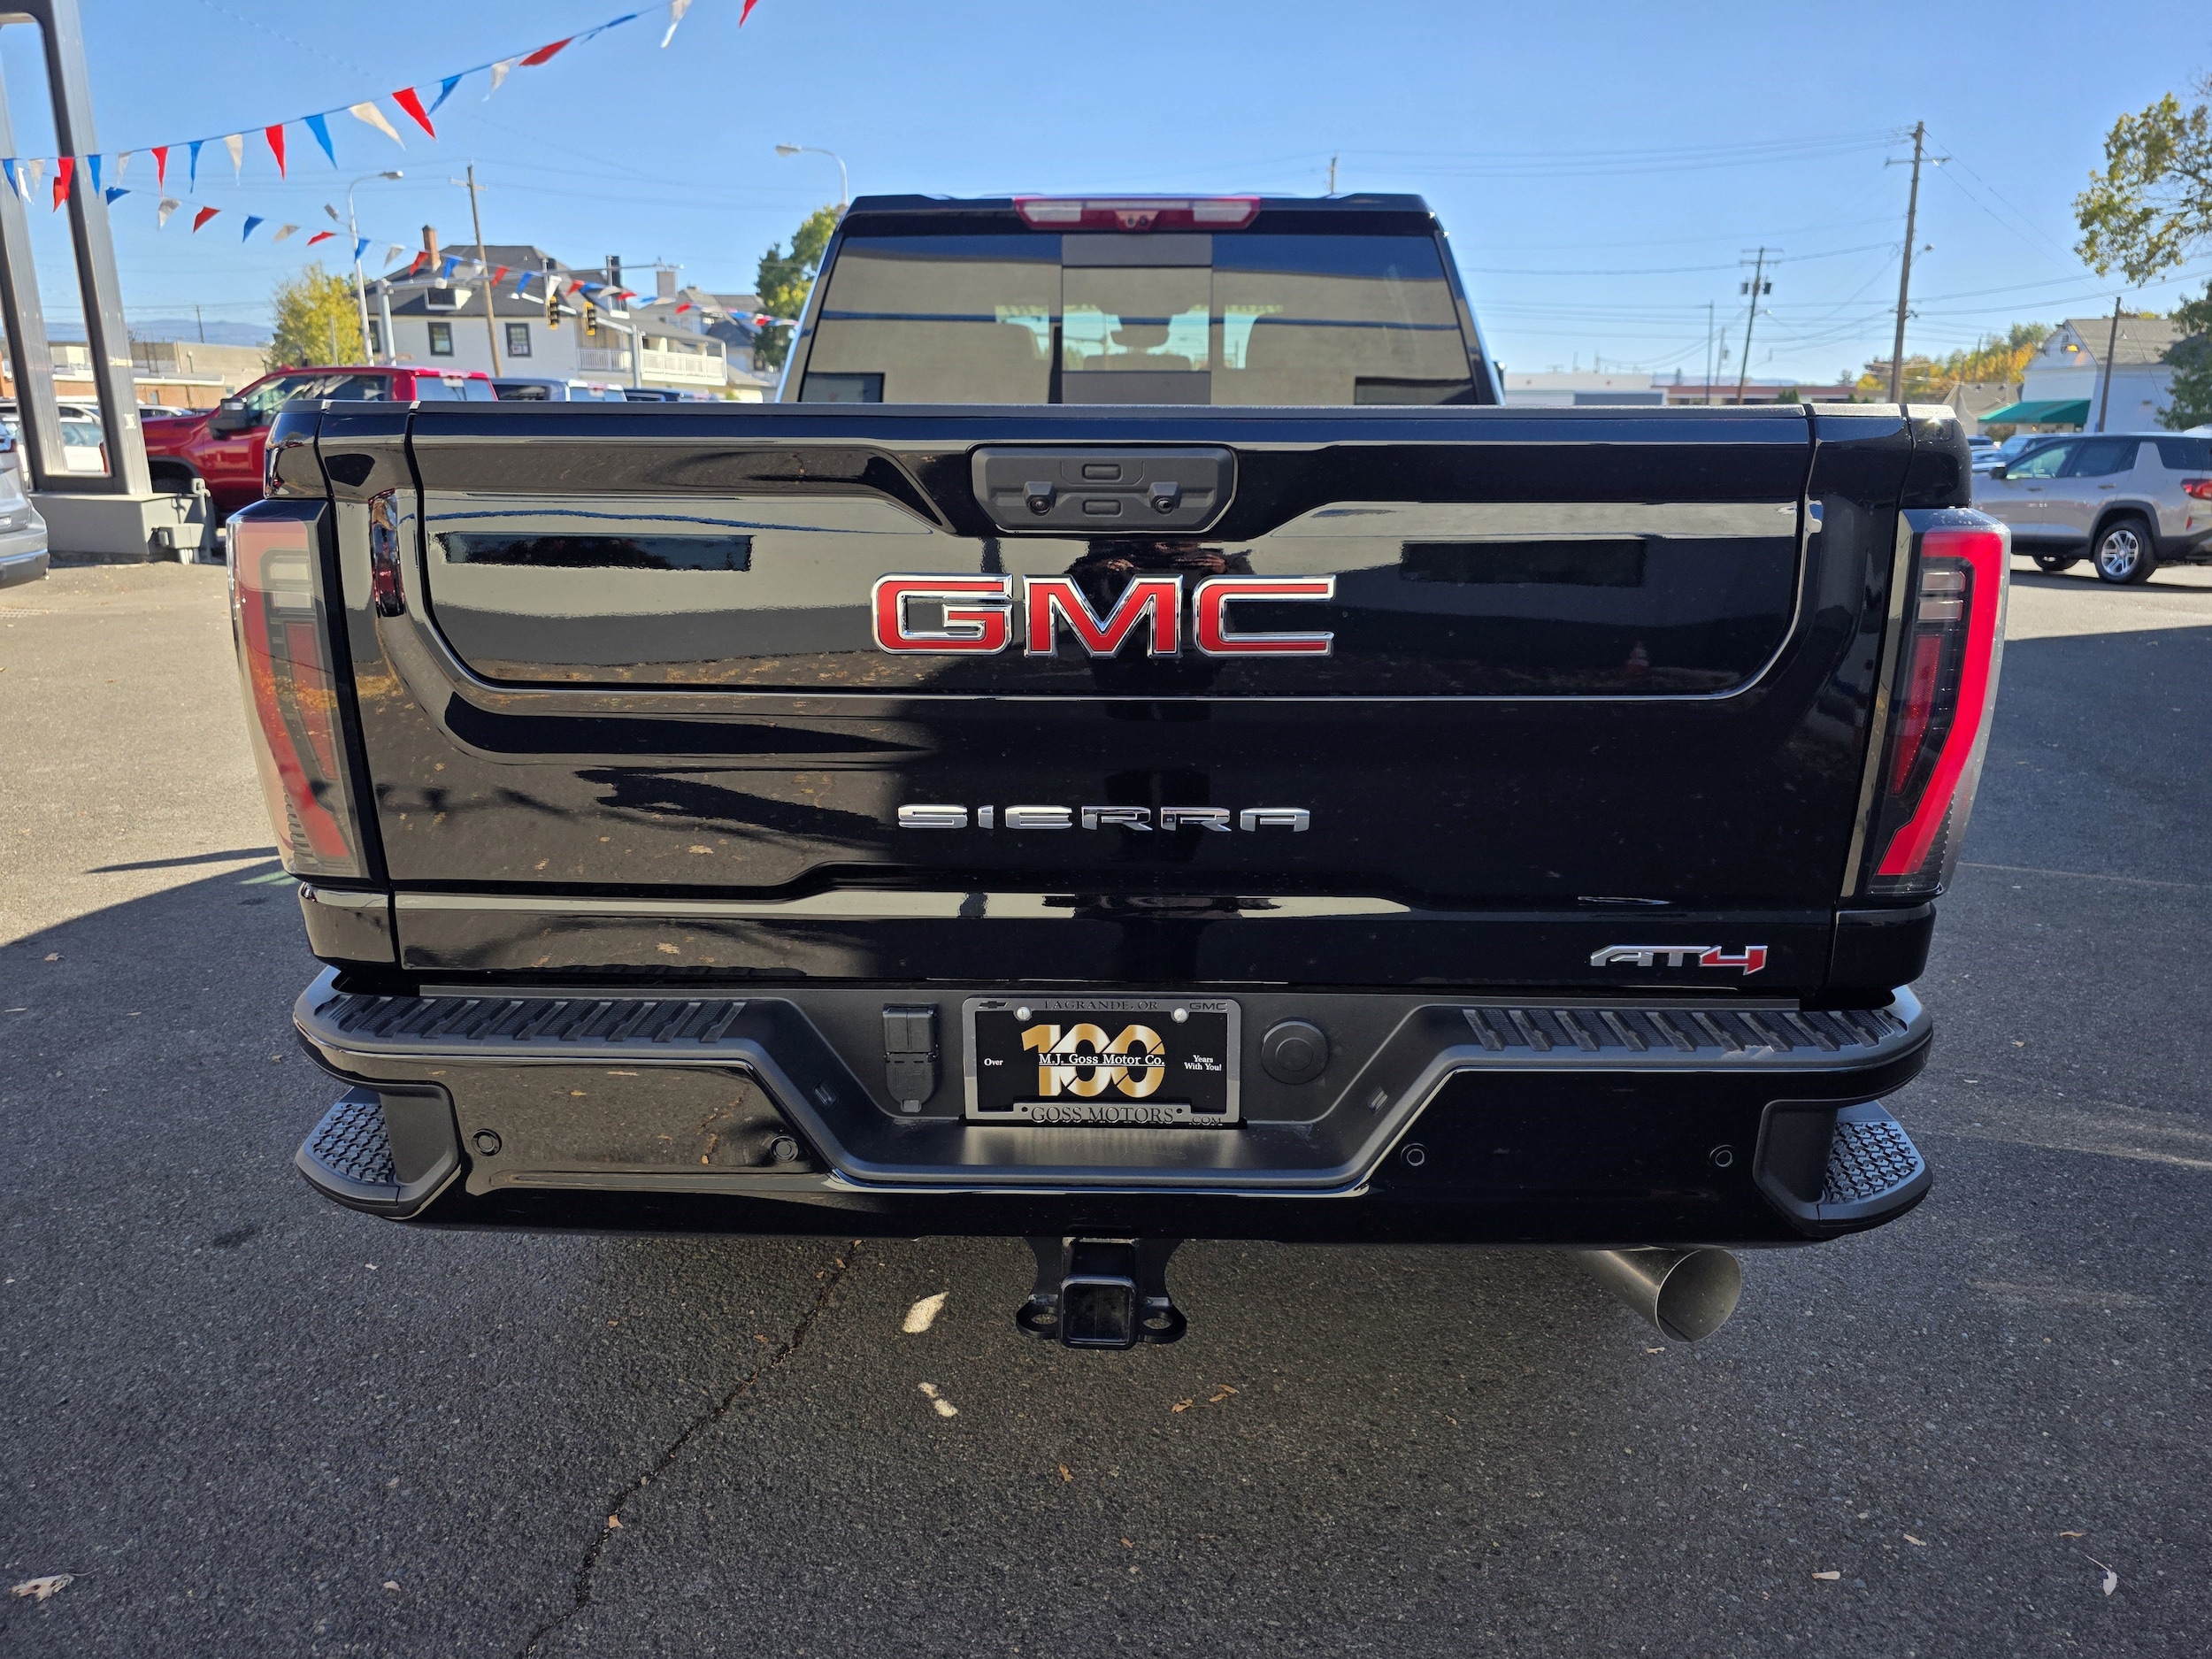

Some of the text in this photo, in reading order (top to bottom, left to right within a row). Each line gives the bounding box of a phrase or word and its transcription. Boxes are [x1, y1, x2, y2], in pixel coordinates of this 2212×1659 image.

[871, 572, 1337, 658] GMC
[897, 804, 1310, 833] SIERRA
[1590, 944, 1769, 976] AT4
[1137, 1001, 1158, 1010] OR
[1189, 1002, 1228, 1011] GMC
[983, 1057, 1004, 1067] Over
[1020, 1022, 1165, 1099] 100
[1038, 1053, 1165, 1066] M.J. Goss Motor Co.
[1192, 1055, 1214, 1064] Years
[1184, 1062, 1222, 1071] With You!
[1030, 1105, 1174, 1125] GOSS MOTORS
